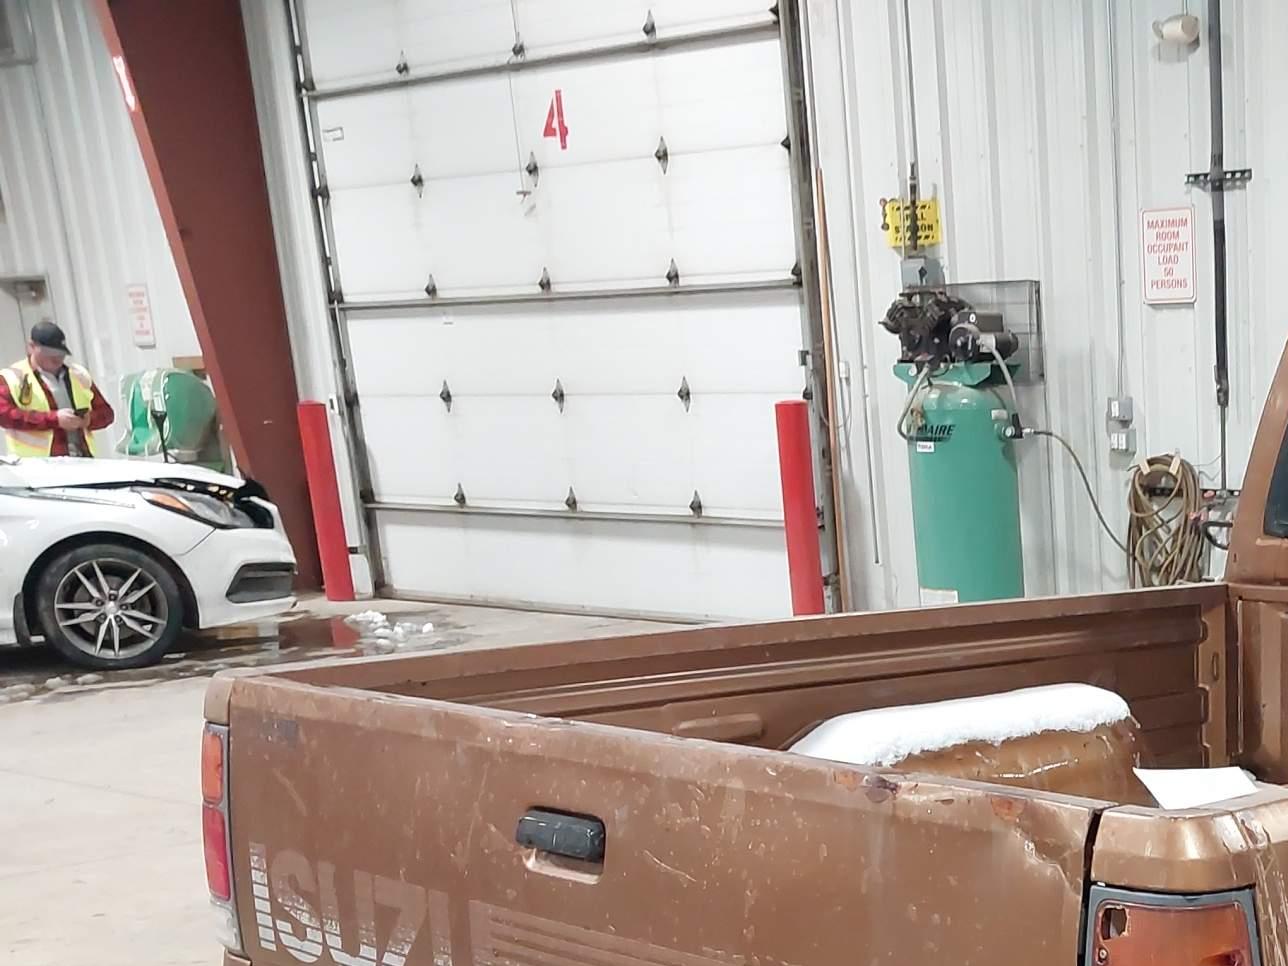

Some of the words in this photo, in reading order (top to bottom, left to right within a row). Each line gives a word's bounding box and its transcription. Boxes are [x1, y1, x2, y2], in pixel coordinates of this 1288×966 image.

[543, 90, 568, 149] 4
[1147, 218, 1188, 229] MAXIMUM
[1156, 230, 1180, 241] ROOM
[1147, 242, 1189, 254] OCCUPANT
[1157, 254, 1179, 265] LOAD
[1150, 278, 1188, 289] PERSONS
